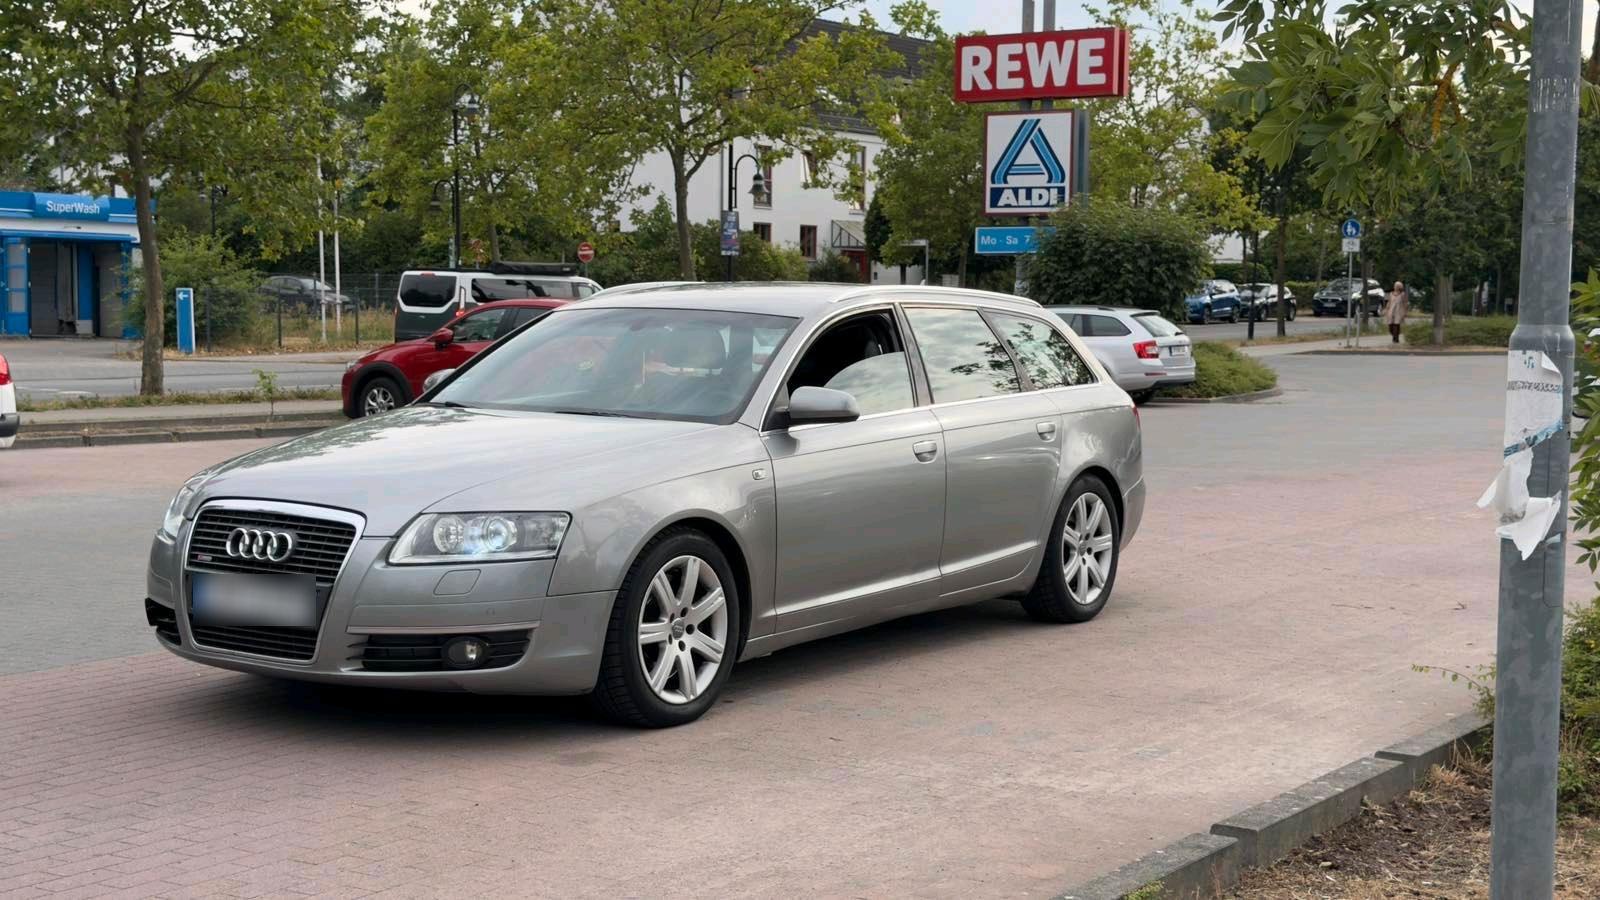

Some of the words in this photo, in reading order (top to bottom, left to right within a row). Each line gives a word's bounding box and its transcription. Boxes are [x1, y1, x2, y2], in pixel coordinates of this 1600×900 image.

[961, 38, 1106, 91] REWE
[997, 188, 1058, 206] ALDI
[46, 200, 100, 215] SuperWash
[980, 235, 997, 245] Mo
[1006, 235, 1018, 245] Sa
